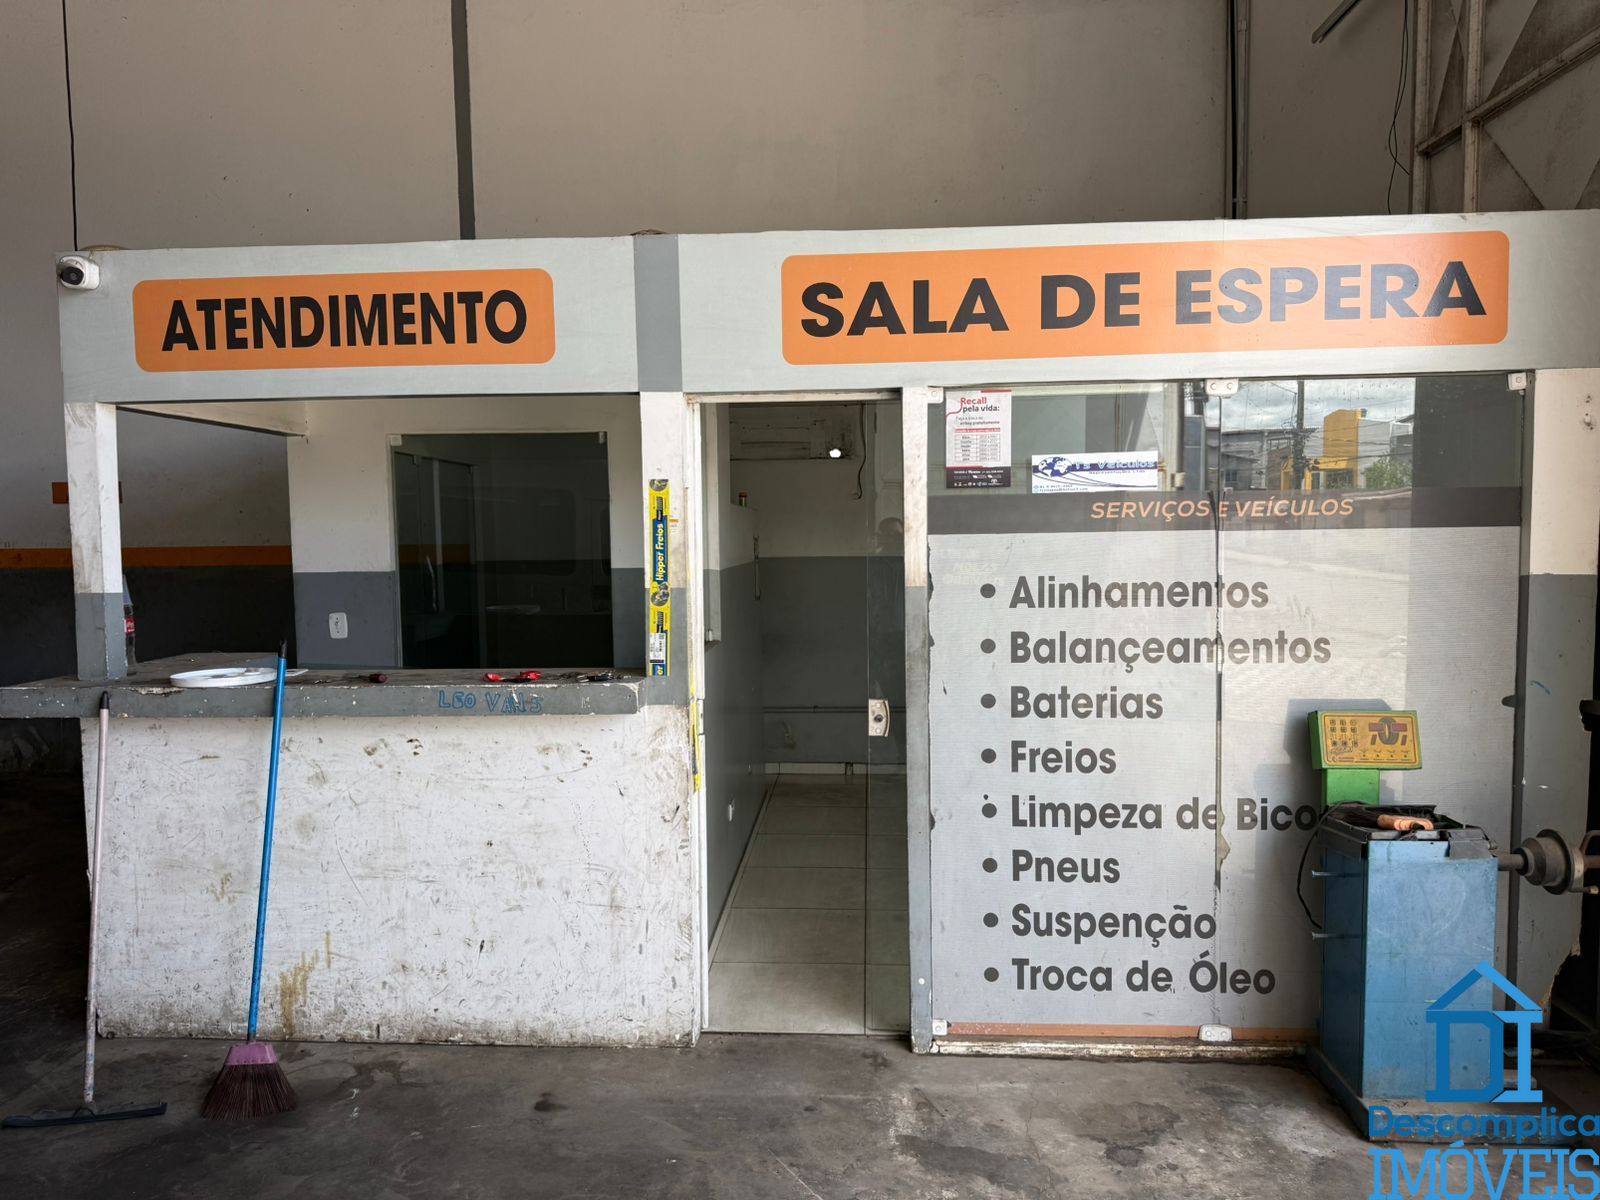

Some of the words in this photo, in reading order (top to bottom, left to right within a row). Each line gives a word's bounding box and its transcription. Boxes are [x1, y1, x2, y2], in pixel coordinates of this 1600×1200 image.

[801, 277, 1010, 337] SALA
[1040, 271, 1141, 330] DE
[1175, 260, 1487, 325] ESPERA
[161, 289, 527, 352] ATENDIMENTO
[960, 397, 987, 405] Recall
[962, 405, 979, 414] pela
[981, 404, 1000, 412] vida:
[1090, 499, 1210, 522] SERVIÇOS
[1218, 501, 1230, 517] E
[1235, 496, 1354, 518] VEÍCULOS
[654, 523, 665, 550] Freios
[654, 551, 665, 582] Hipper
[1009, 575, 1269, 608] Alinhamentos
[1010, 630, 1331, 673] Balançeamentos
[1010, 685, 1163, 719] Baterias
[1010, 740, 1117, 774] Freios
[1011, 795, 1162, 835] Limpeza
[1176, 797, 1217, 830] de
[1236, 798, 1317, 831] Bico
[1012, 849, 1120, 884] Pneus
[1012, 904, 1217, 948] Suspenção
[1011, 958, 1112, 992] Troca
[1126, 960, 1173, 993] de
[1189, 950, 1276, 994] Óleo
